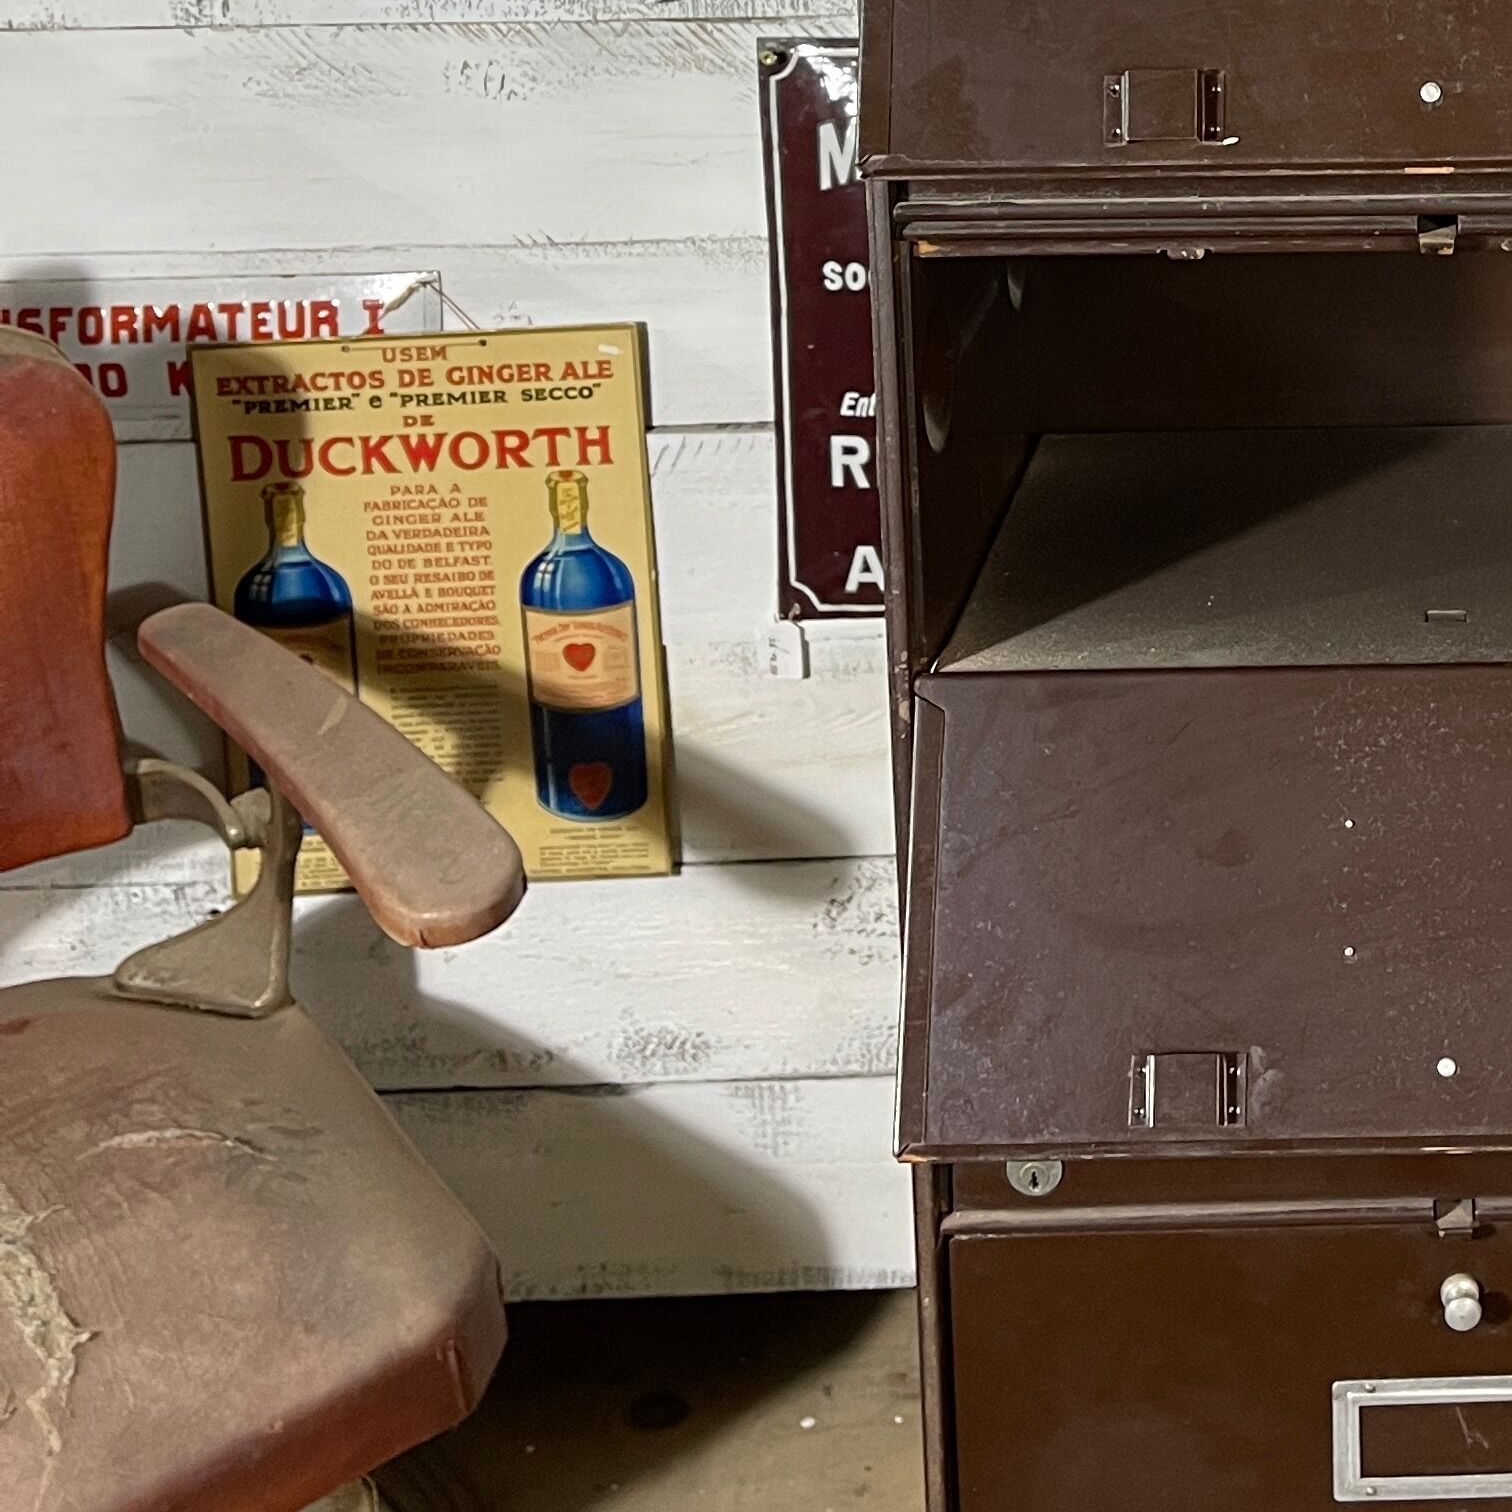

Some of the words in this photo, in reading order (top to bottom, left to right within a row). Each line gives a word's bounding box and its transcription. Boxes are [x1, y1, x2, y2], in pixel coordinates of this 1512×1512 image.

[382, 345, 448, 364] USEM
[216, 370, 385, 397] EXTRACTOS
[399, 368, 434, 388] DE
[445, 363, 553, 386] GINGER
[560, 359, 614, 381] ALE
[403, 414, 434, 428] DE
[227, 425, 614, 482] DUCKWORTH
[390, 484, 438, 496] PARA
[451, 483, 462, 494] A
[468, 496, 488, 508] DE
[366, 530, 388, 541] DA
[393, 525, 490, 540] VERDADEIRA
[367, 542, 442, 556] QUALIDADE
[372, 559, 392, 570] DO
